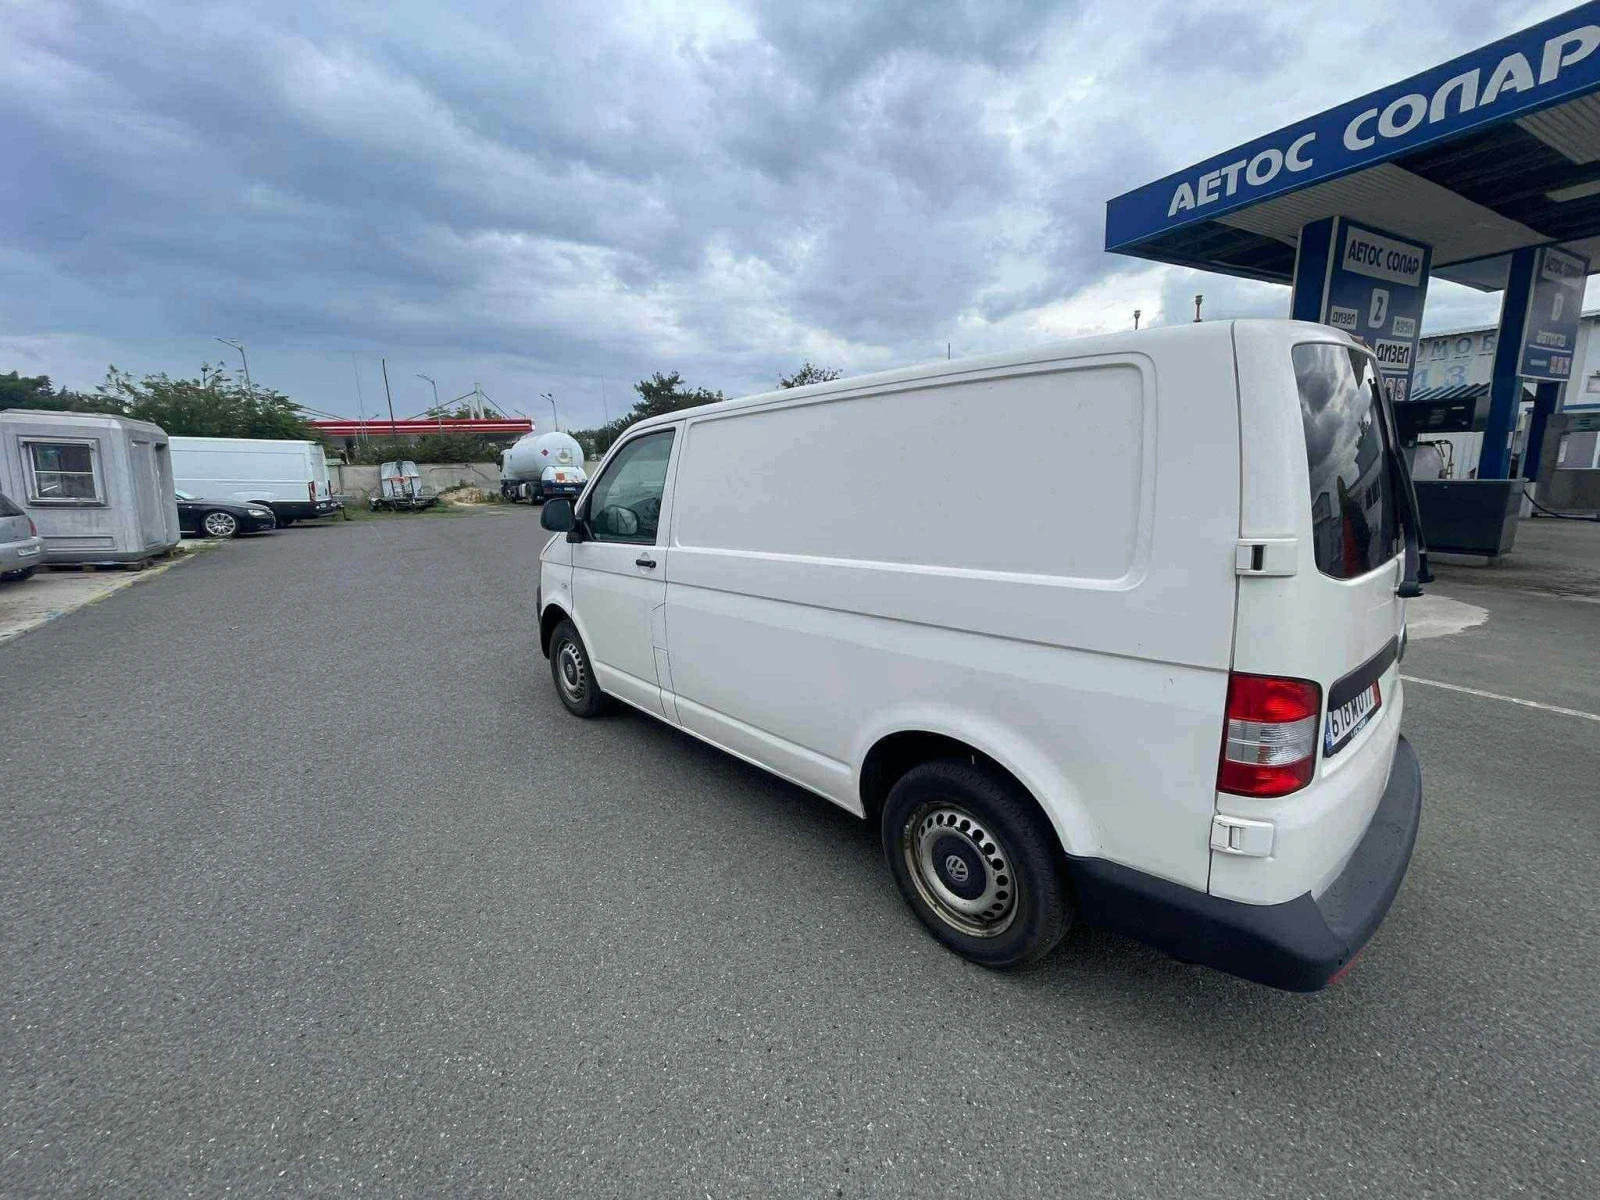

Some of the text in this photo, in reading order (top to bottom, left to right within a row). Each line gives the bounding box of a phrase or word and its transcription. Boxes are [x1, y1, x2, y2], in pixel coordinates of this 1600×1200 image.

[1167, 132, 1316, 218] АЕТОС
[1348, 239, 1383, 268] АЕТОС
[1374, 296, 1383, 322] 2
